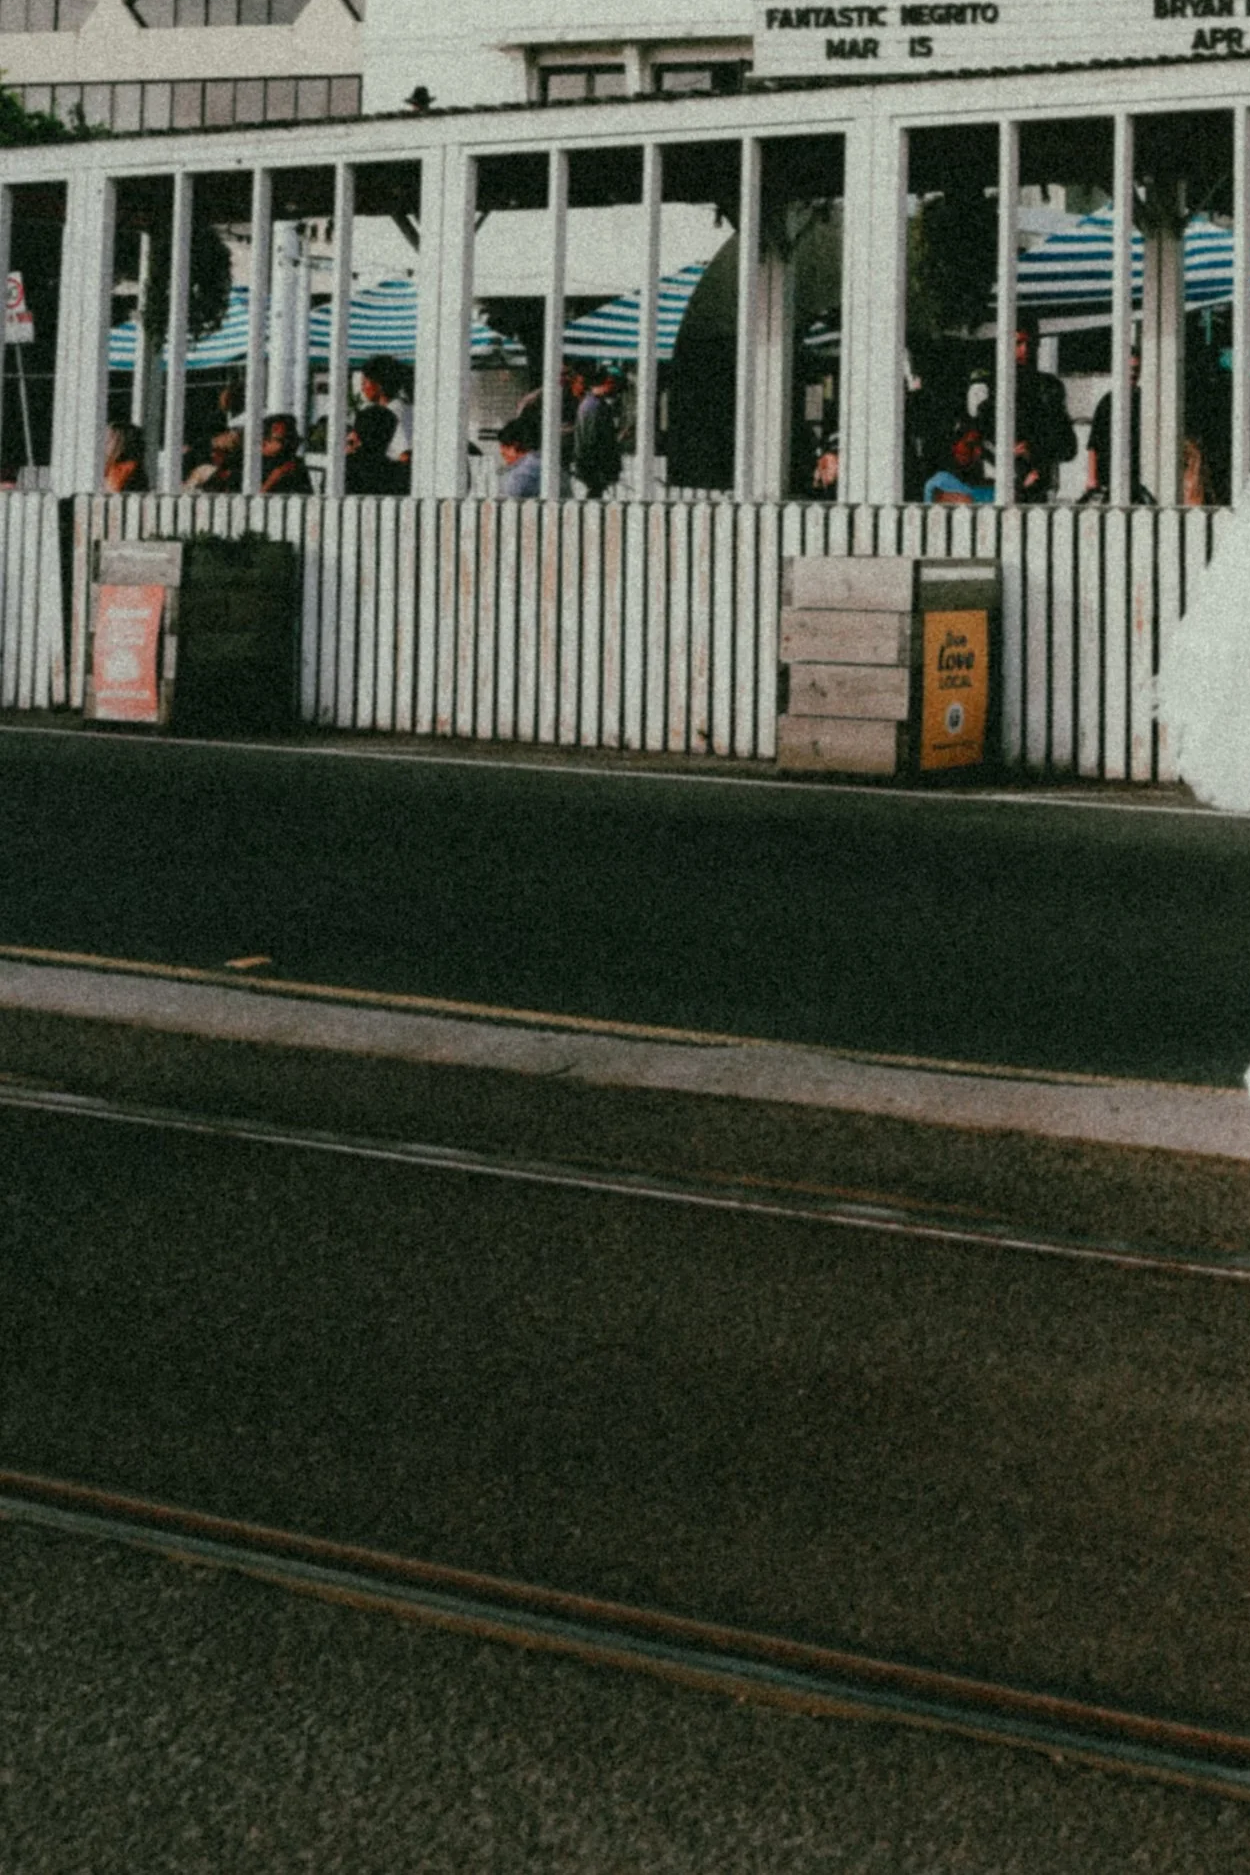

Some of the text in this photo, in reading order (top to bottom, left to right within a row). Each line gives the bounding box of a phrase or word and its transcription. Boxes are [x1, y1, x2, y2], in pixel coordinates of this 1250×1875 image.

[765, 2, 1000, 30] FANTASTIC NEGRITO
[825, 37, 880, 61] MAR
[1191, 27, 1244, 51] APR
